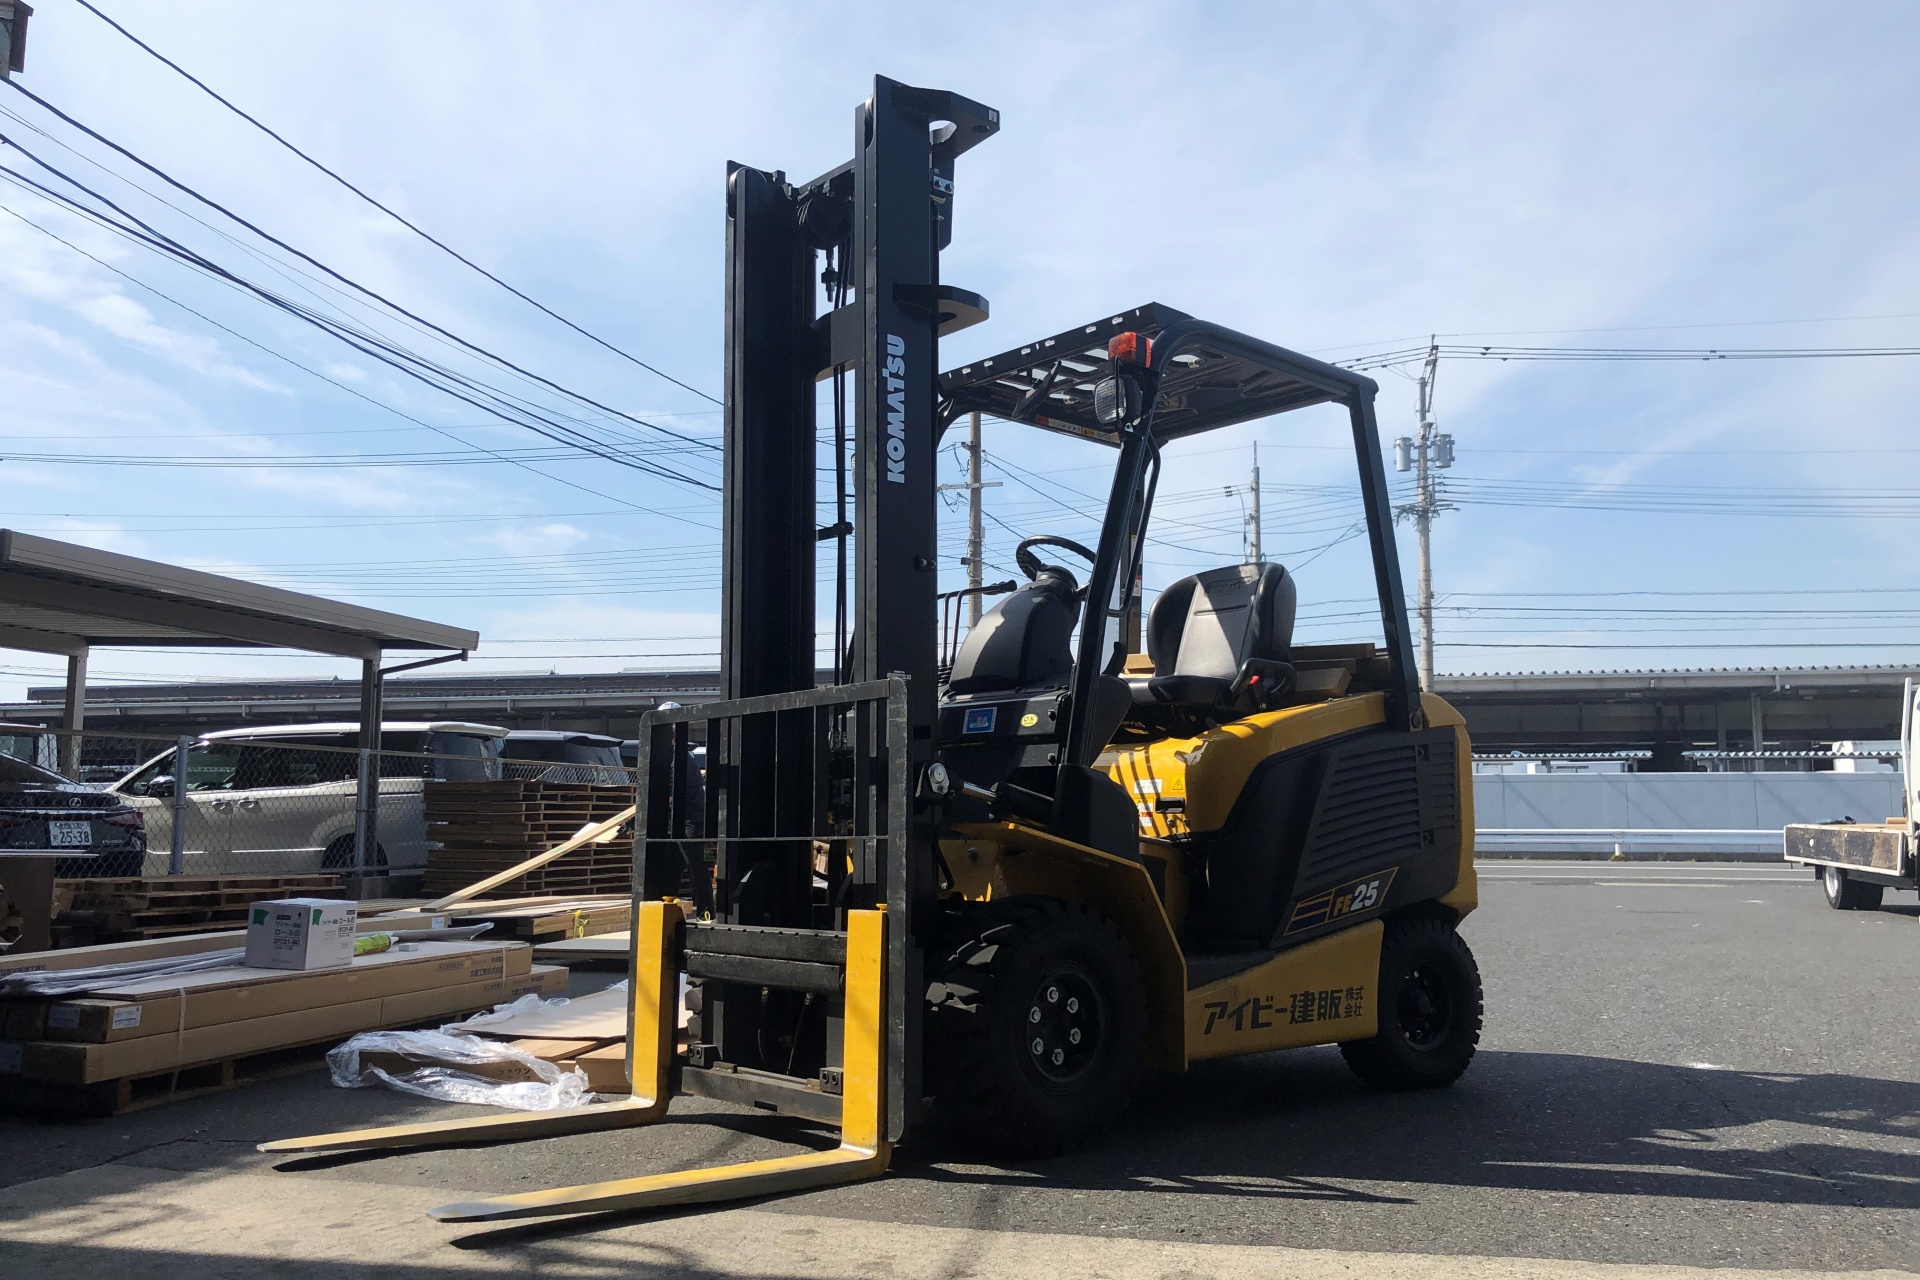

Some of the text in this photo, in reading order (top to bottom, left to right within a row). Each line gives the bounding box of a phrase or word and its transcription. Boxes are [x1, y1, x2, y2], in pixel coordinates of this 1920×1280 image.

[882, 334, 905, 484] KOMATSU
[1023, 715, 1035, 723] OK
[60, 830, 90, 844] 25-38
[1333, 880, 1380, 917] FE25
[1203, 989, 1344, 1035] アイビー建販
